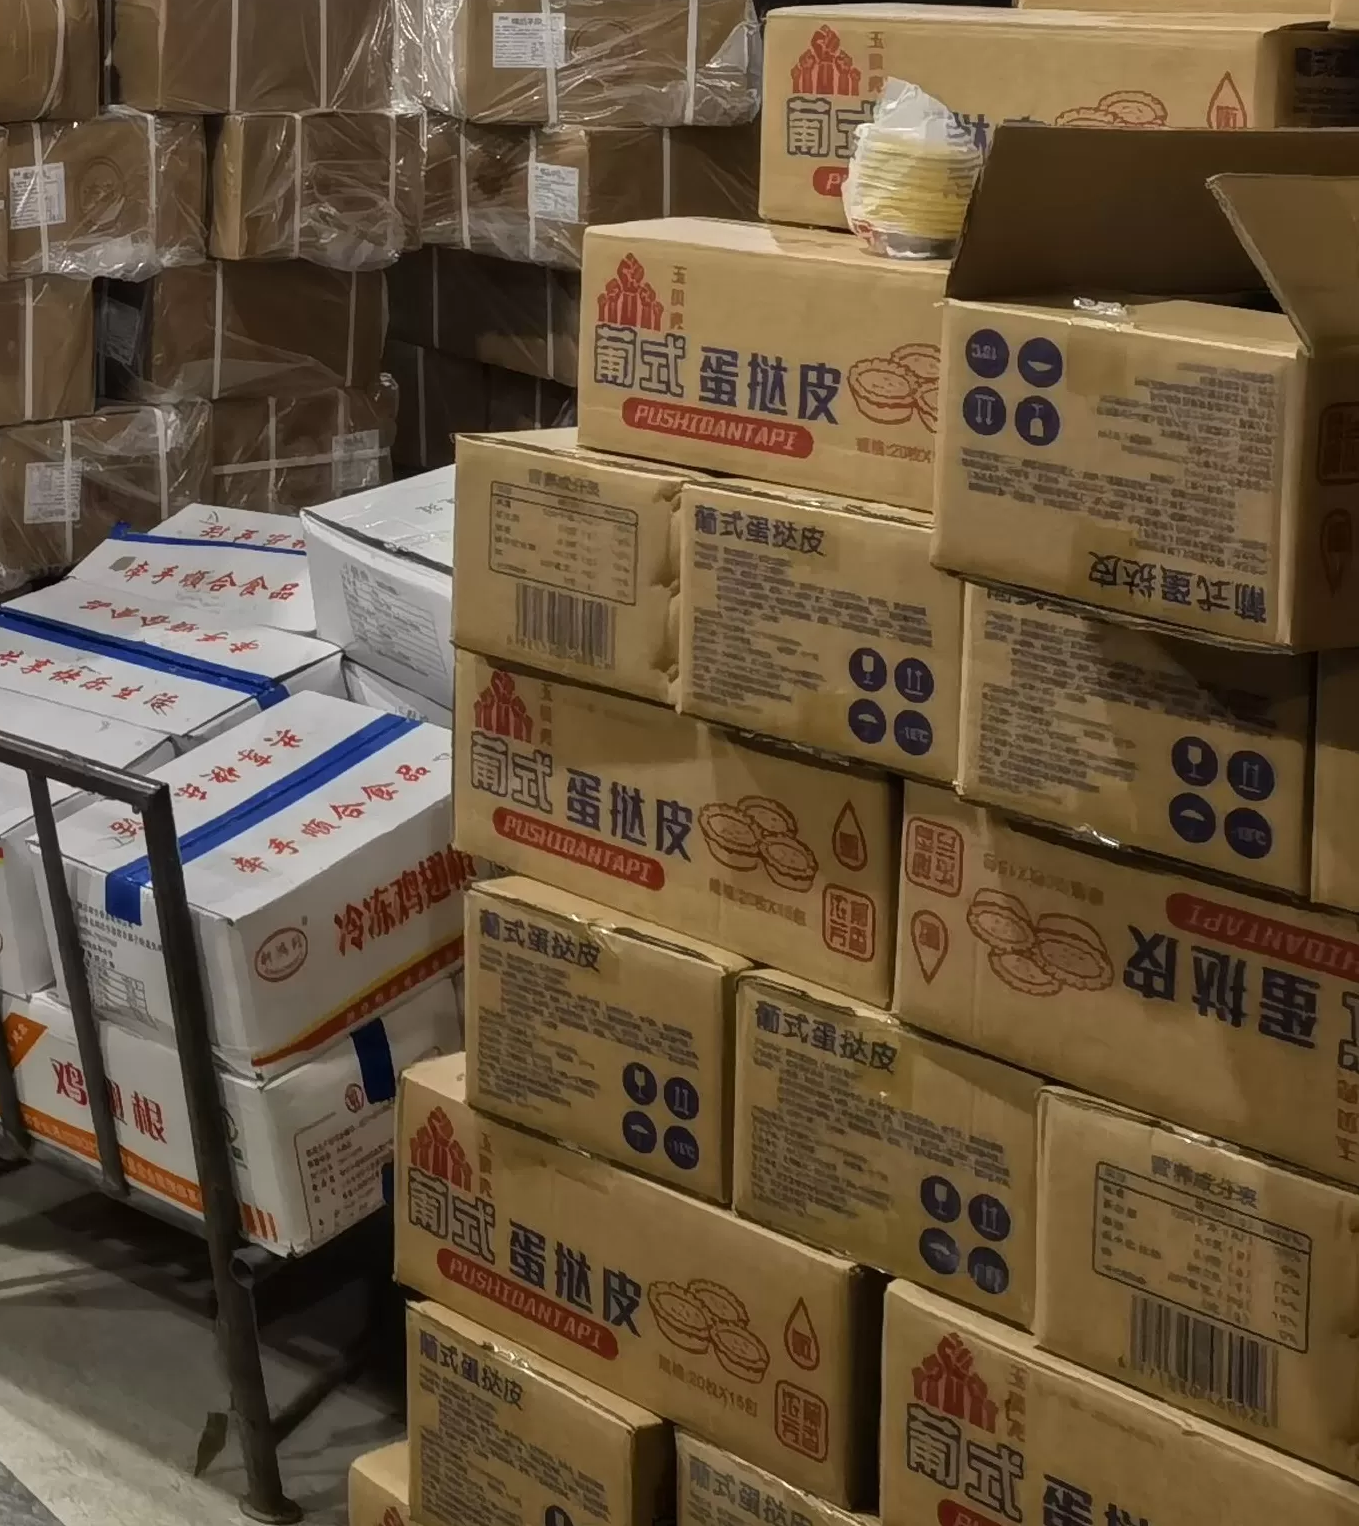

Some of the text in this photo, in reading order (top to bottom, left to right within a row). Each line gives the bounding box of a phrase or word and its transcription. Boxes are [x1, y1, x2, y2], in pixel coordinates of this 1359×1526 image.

[594, 325, 841, 424] 葡式蛋挞皮
[633, 403, 799, 452] PUSHIDANTAPI
[694, 504, 827, 558] 葡式蛋挞皮
[1088, 551, 1267, 624] 葡式蛋挞皮
[109, 729, 303, 837] 共享快乐活
[471, 731, 694, 864] 葡式蛋挞皮
[479, 908, 601, 974] 葡式蛋挞皮
[756, 1000, 898, 1075] 葡式蛋挞皮
[407, 1167, 643, 1339] 葡式蛋挞皮
[449, 1256, 606, 1353] PUSHIDANTAPI
[420, 1328, 525, 1411] 葡式蛋挞皮
